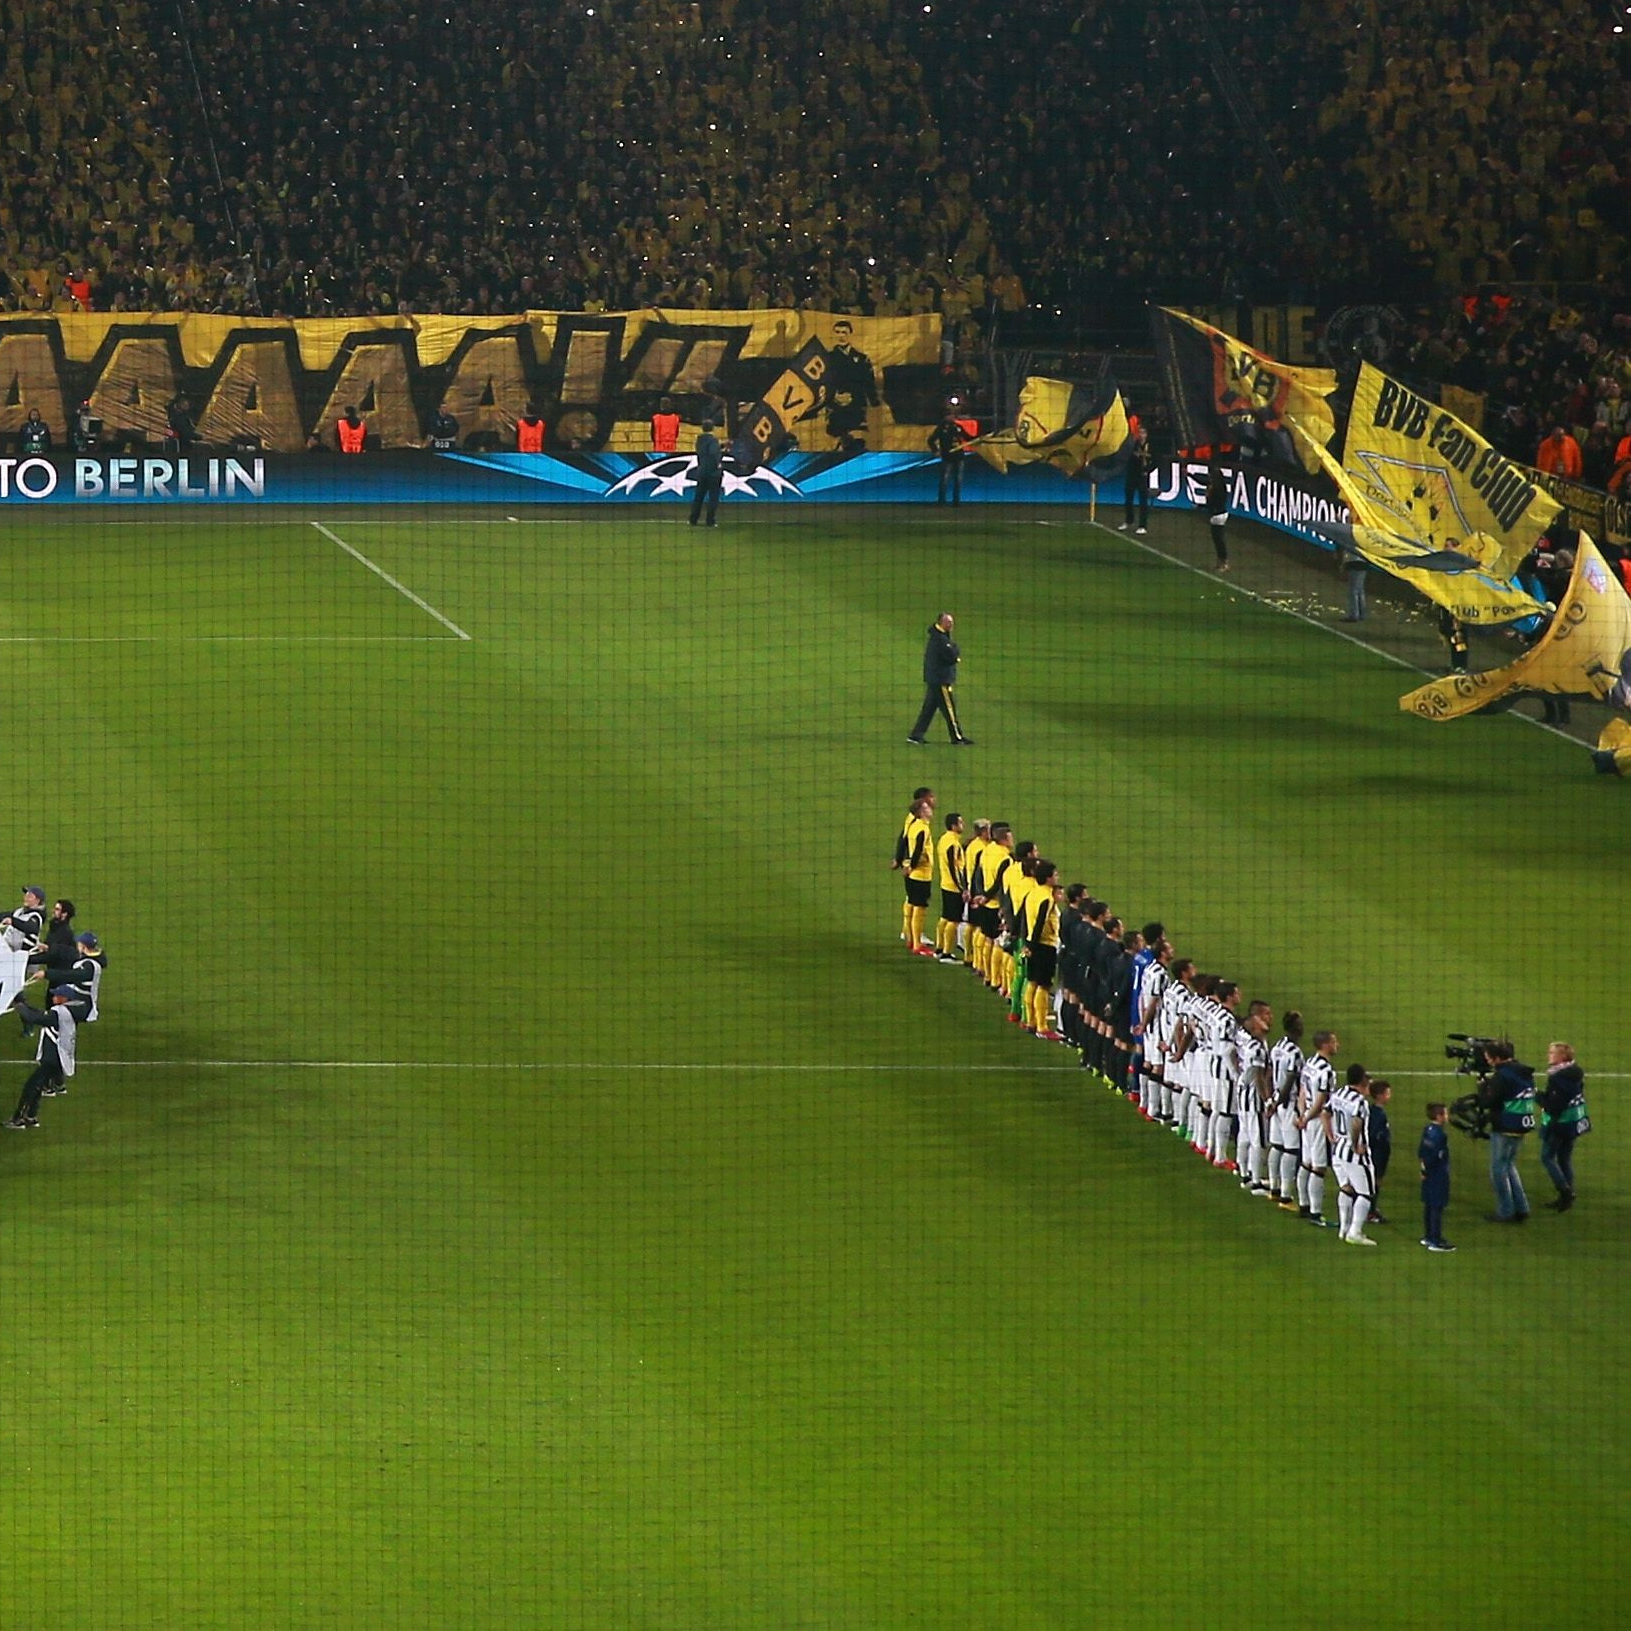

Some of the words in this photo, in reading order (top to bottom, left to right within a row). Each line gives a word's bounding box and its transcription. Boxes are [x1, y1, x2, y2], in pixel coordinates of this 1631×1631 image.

[1374, 377, 1430, 439] BVB
[1427, 412, 1477, 472] Fan
[74, 458, 266, 498] BERLIN
